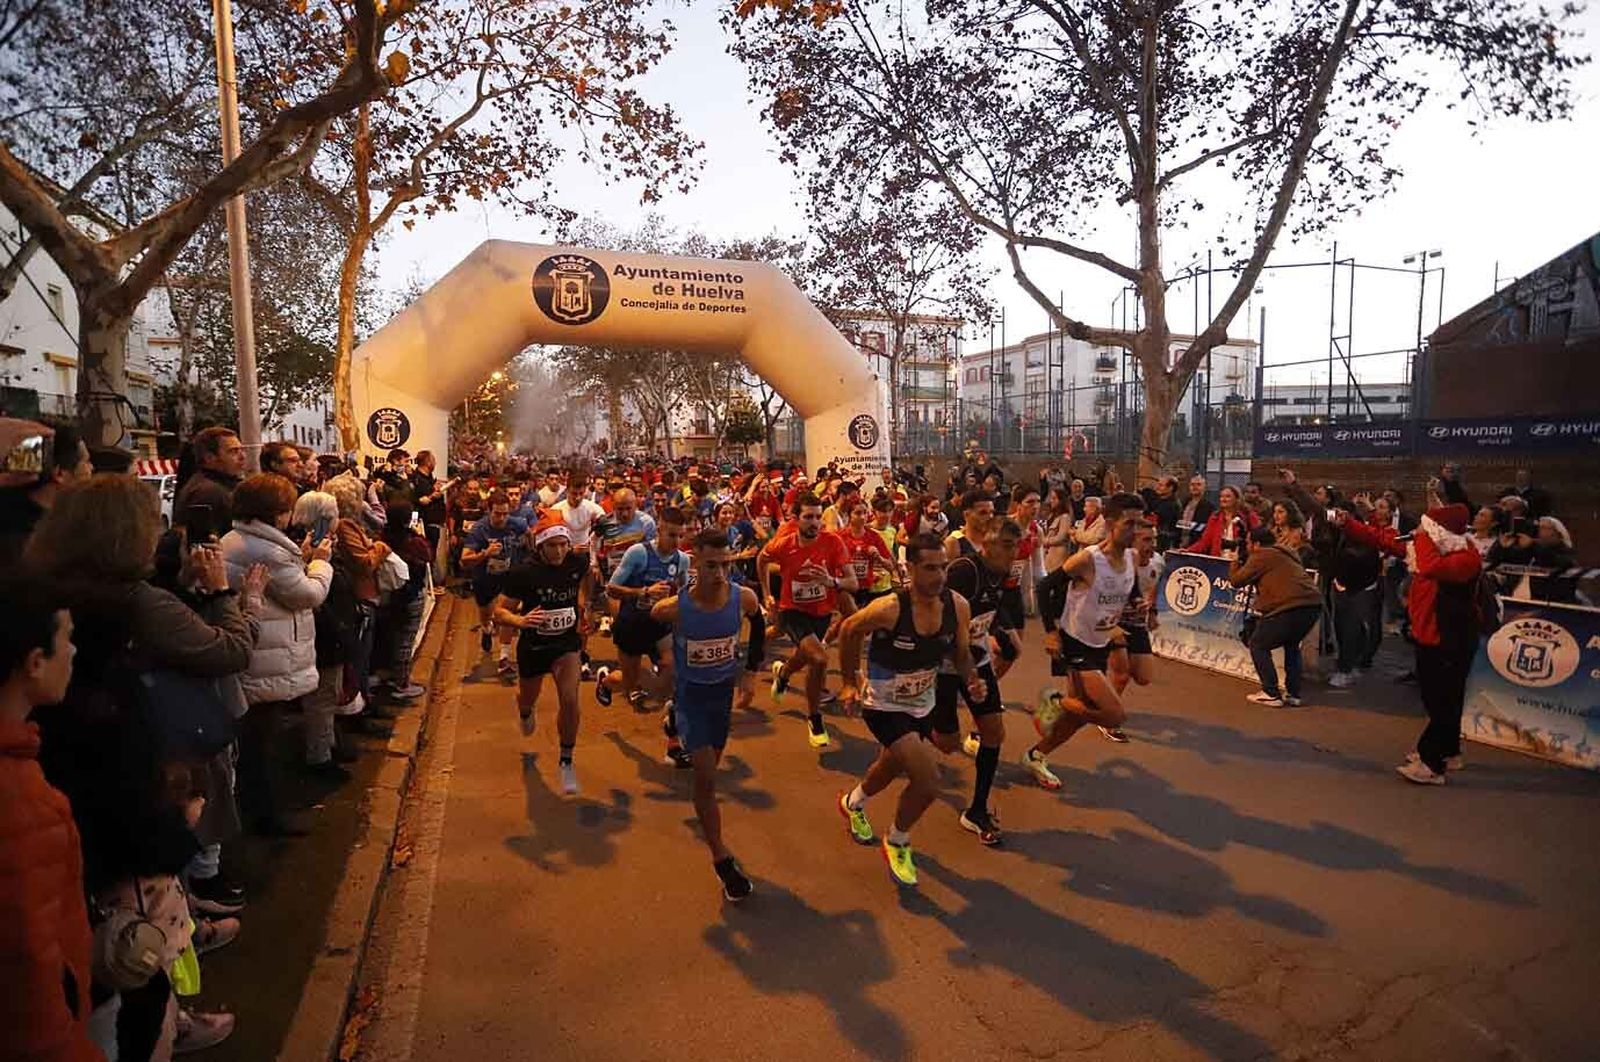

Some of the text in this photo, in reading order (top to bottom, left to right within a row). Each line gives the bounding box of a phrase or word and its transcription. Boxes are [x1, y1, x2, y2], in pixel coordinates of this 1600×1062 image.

[613, 264, 744, 284] Ayuntamiento
[652, 282, 744, 300] de Huelva
[682, 300, 696, 310] de
[698, 302, 747, 314] Deportes
[1281, 432, 1322, 441] HYUNDAI
[1352, 430, 1401, 439] HYUNDAI
[1452, 426, 1513, 436] HYUNDAI
